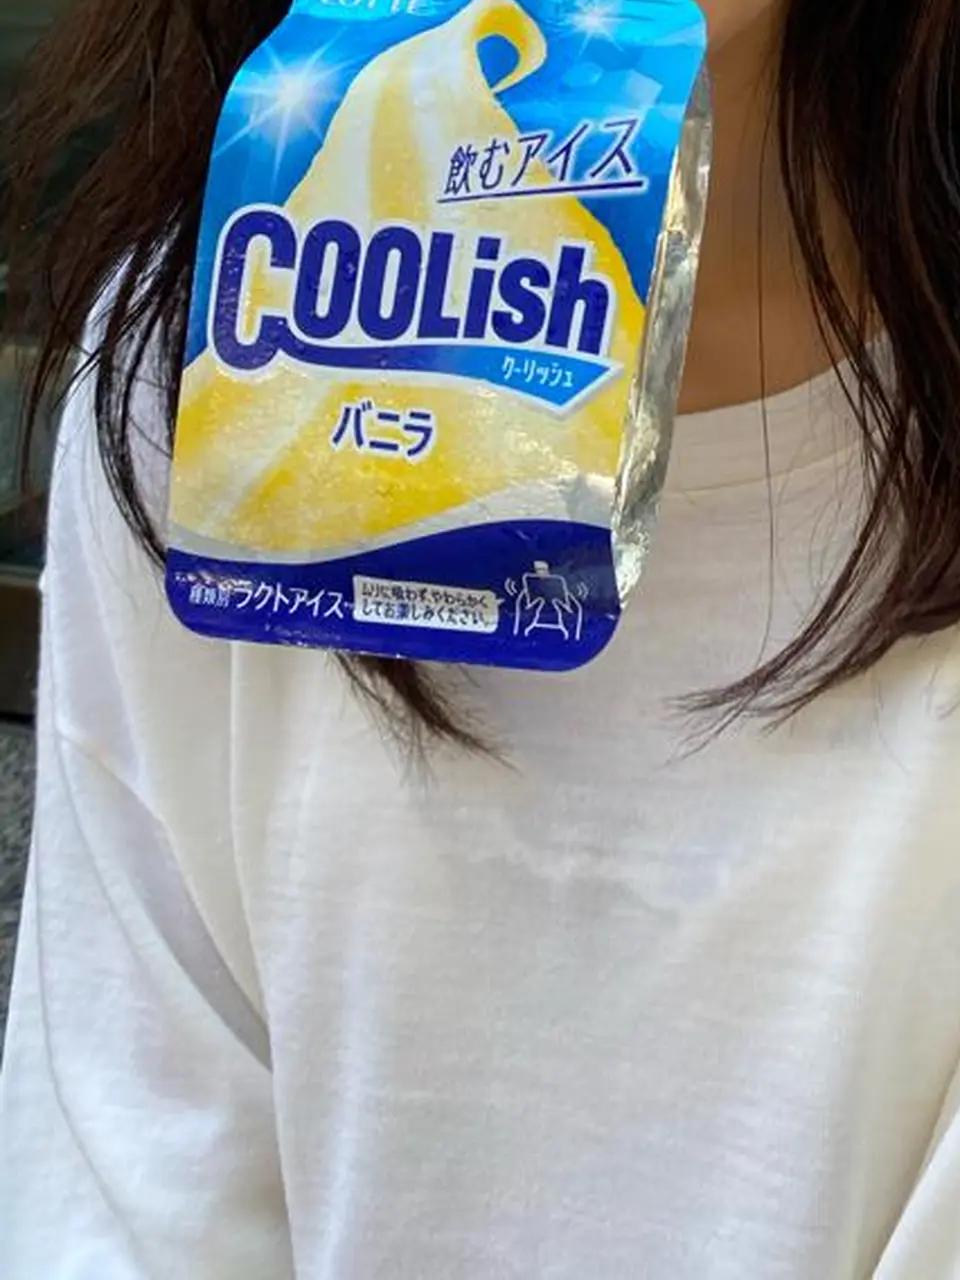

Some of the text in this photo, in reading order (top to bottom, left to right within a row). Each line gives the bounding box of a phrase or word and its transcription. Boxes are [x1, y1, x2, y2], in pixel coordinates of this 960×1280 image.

[444, 118, 639, 196] 飲むアイス
[212, 210, 609, 371] COOLish
[502, 355, 574, 388] クーリッシュ
[332, 400, 434, 457] バニラ
[234, 580, 344, 619] ラクトアイス
